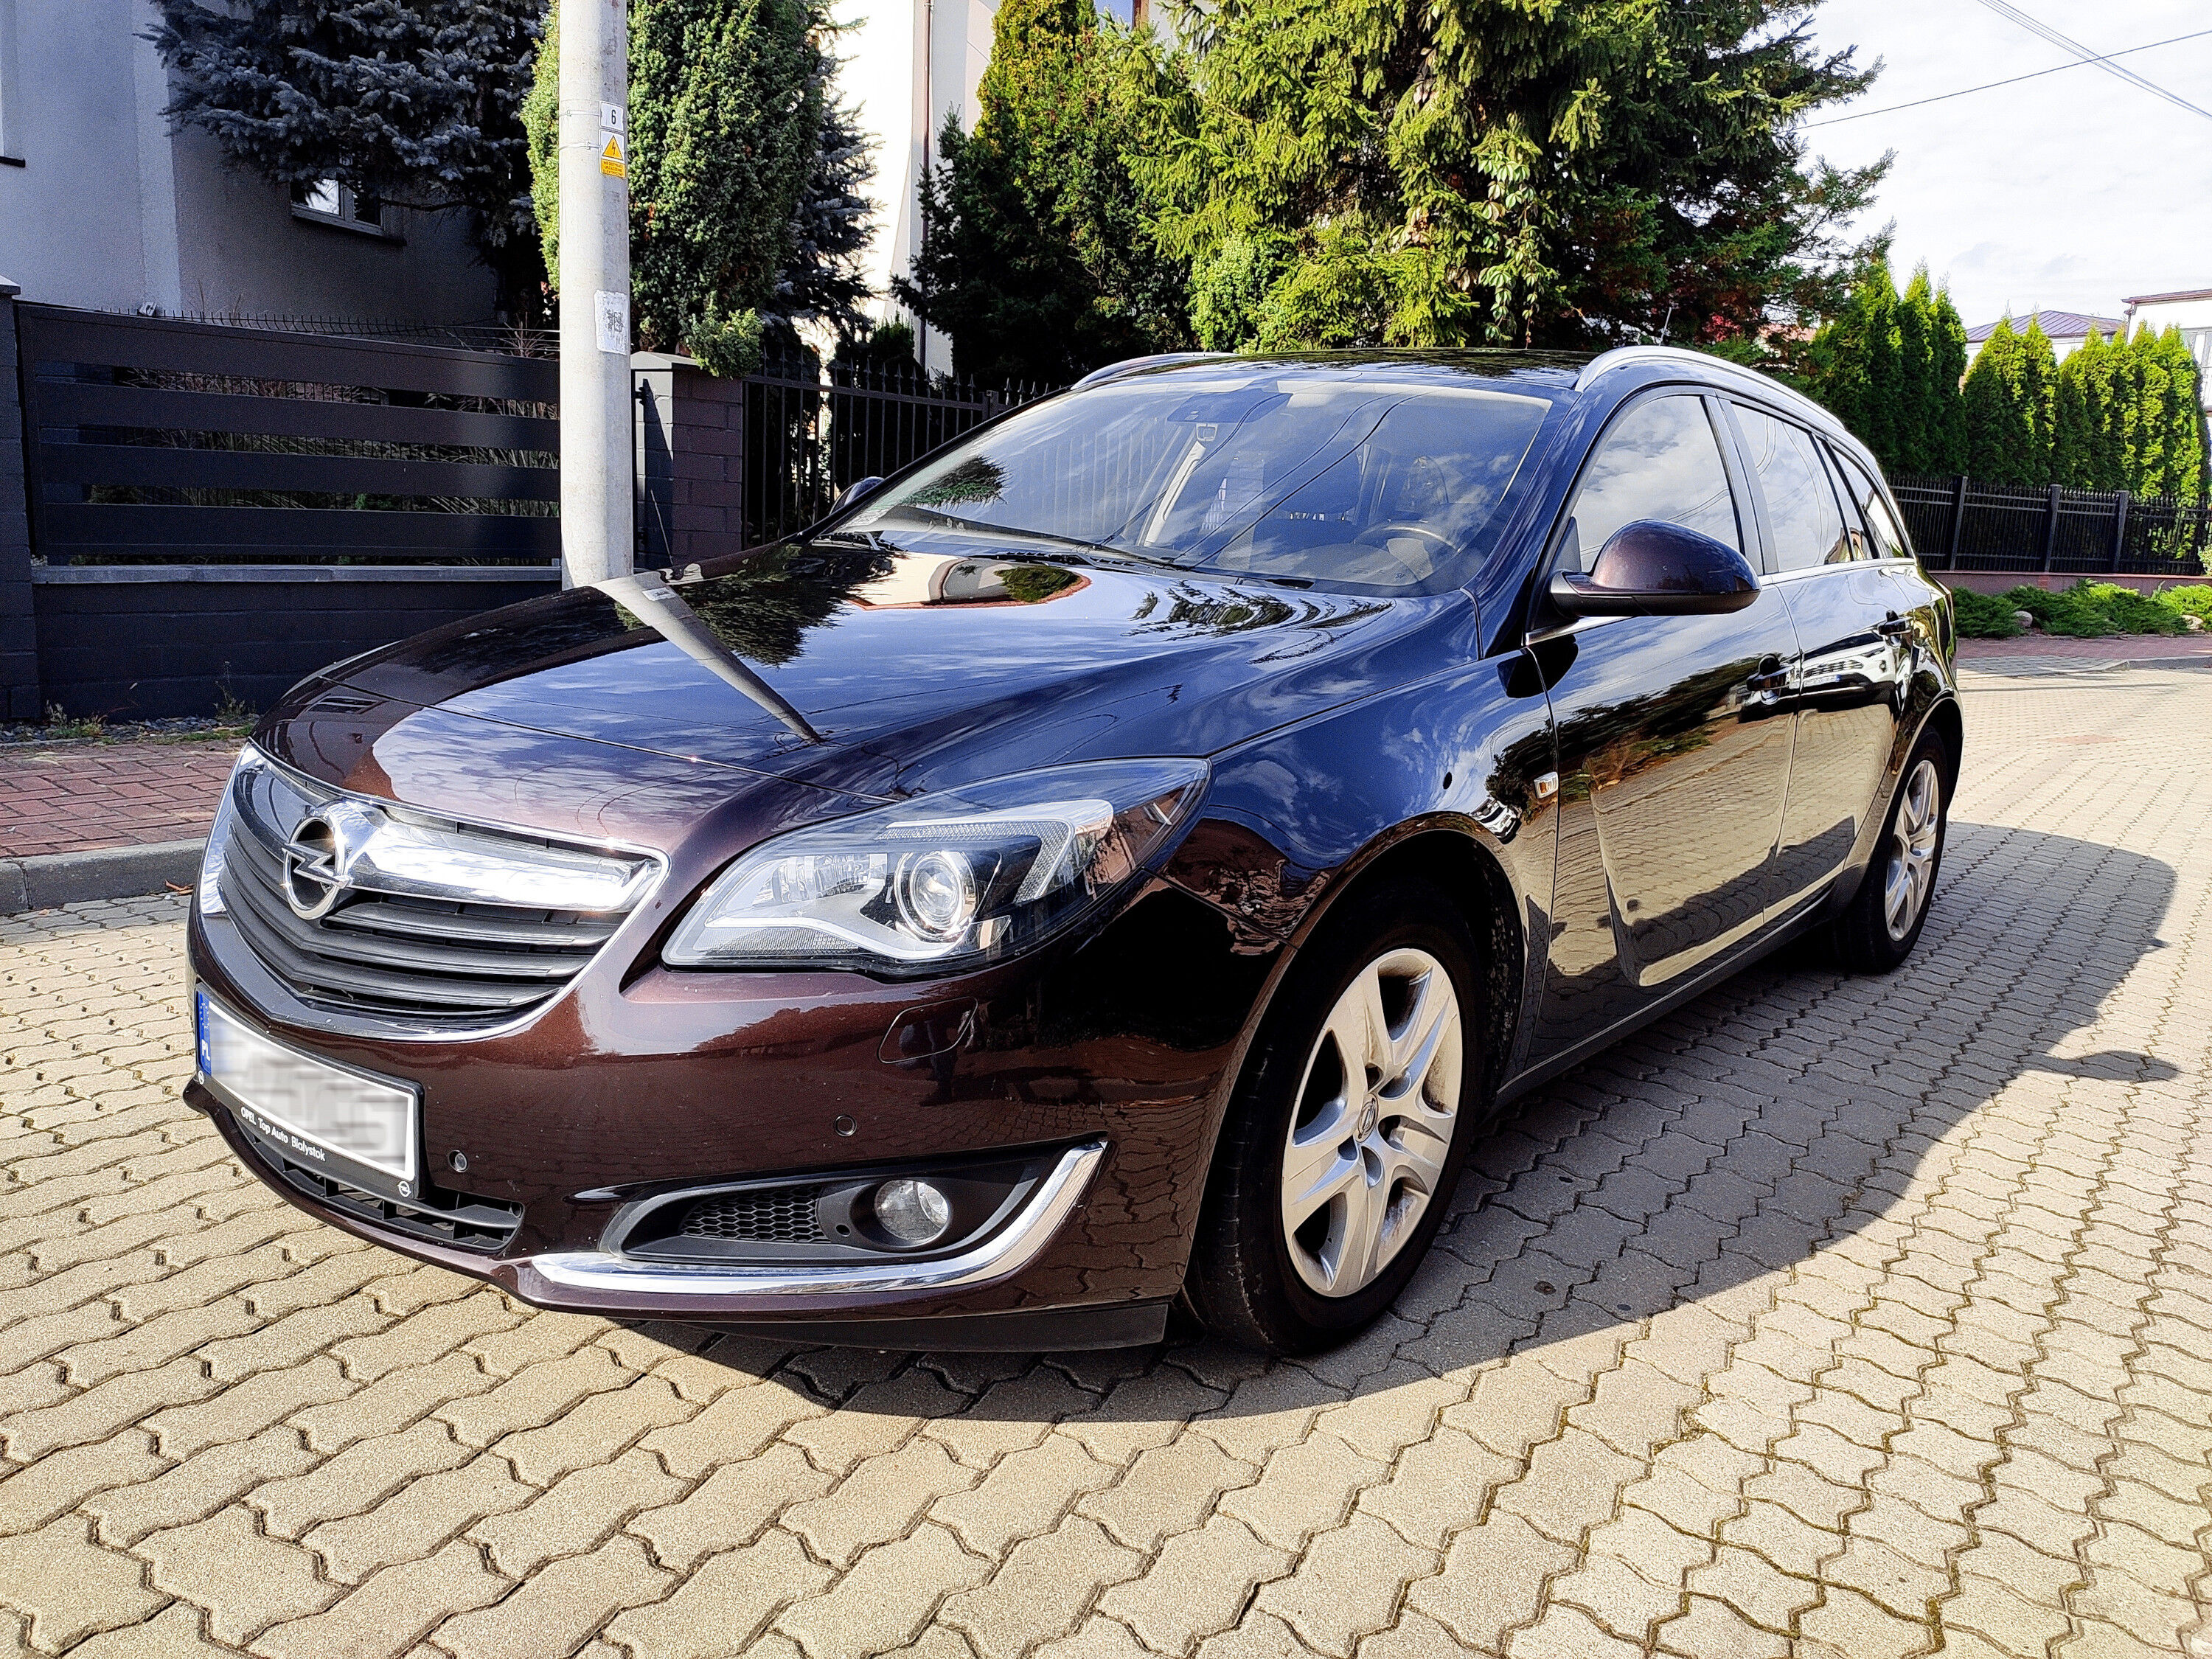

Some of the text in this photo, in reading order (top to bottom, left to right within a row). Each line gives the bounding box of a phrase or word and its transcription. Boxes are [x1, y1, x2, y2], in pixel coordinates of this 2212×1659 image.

[611, 109, 616, 125] 6
[201, 1039, 211, 1062] PL
[240, 1106, 257, 1125] OPEL
[257, 1117, 271, 1135] Top
[271, 1126, 288, 1144] Auto
